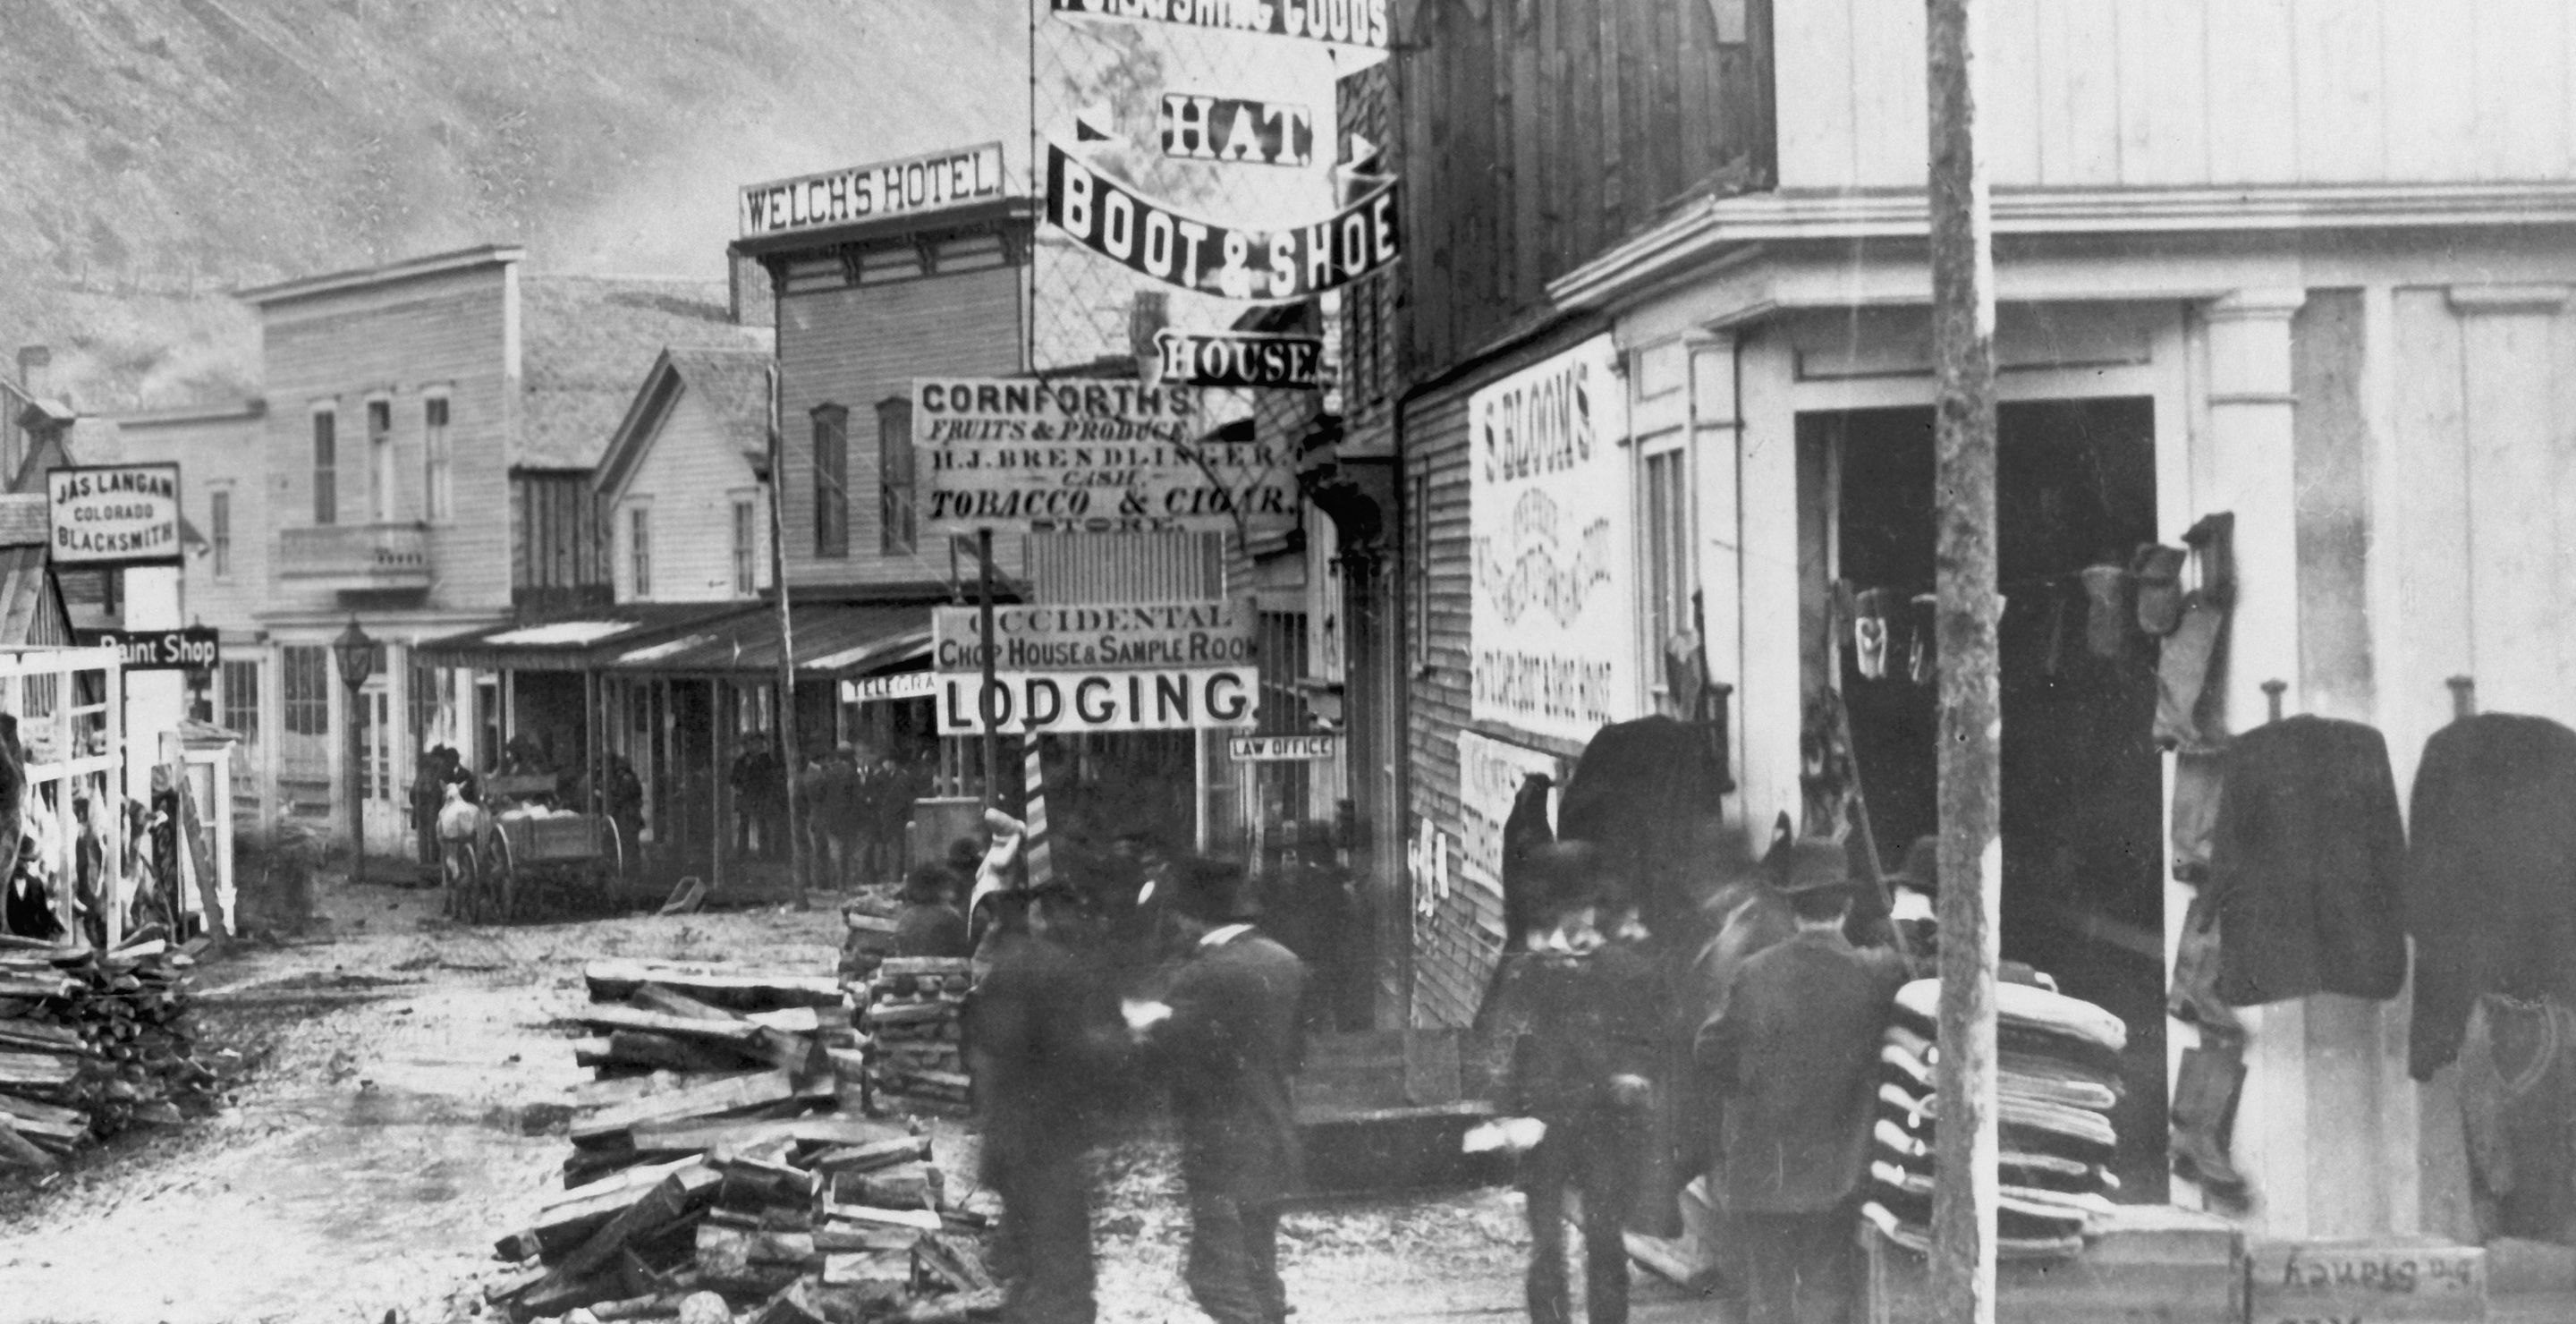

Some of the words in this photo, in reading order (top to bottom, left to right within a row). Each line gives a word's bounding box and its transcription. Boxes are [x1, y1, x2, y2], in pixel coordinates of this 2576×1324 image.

[1062, 156, 1208, 289] BOOT
[1220, 230, 1250, 299] &
[1269, 192, 1395, 298] SHOE
[929, 419, 1028, 446] FRUITS
[1030, 419, 1055, 441] &
[97, 473, 174, 497] LANGAN
[74, 503, 154, 523] COLORADO
[928, 488, 1091, 521] TOBACCO
[1118, 488, 1146, 515] &
[58, 522, 174, 553] BLACKSMITH
[164, 634, 216, 668] Shop
[1008, 637, 1080, 666] HOUSE
[1083, 644, 1097, 666] &
[1099, 634, 1184, 664] SAMPLE
[1233, 737, 1266, 757] LAW
[1272, 736, 1331, 756] OFFICE
